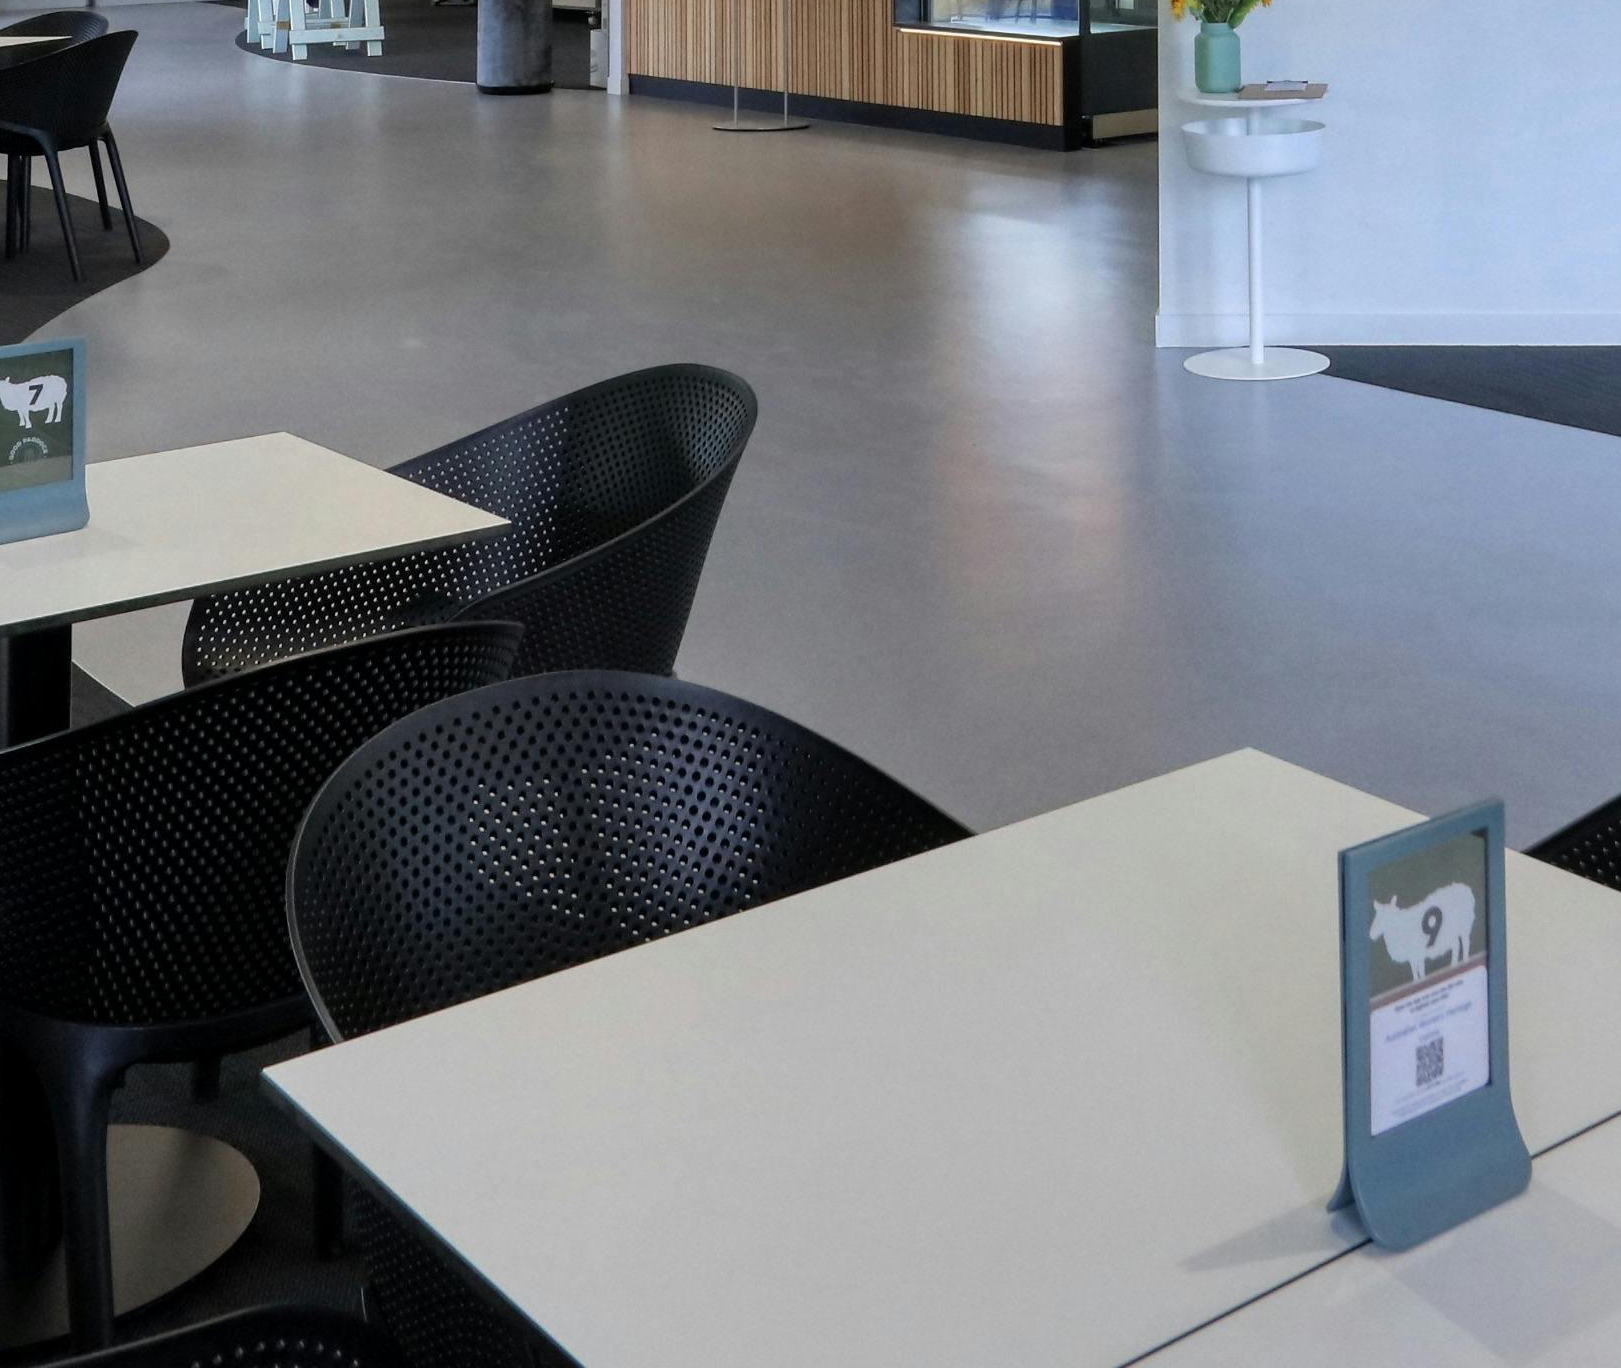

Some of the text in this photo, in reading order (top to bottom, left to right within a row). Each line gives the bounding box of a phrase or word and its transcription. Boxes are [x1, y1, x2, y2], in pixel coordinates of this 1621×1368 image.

[28, 383, 44, 406] 7
[9, 436, 48, 461] GOOD PADDOCK
[1421, 905, 1443, 948] 9
